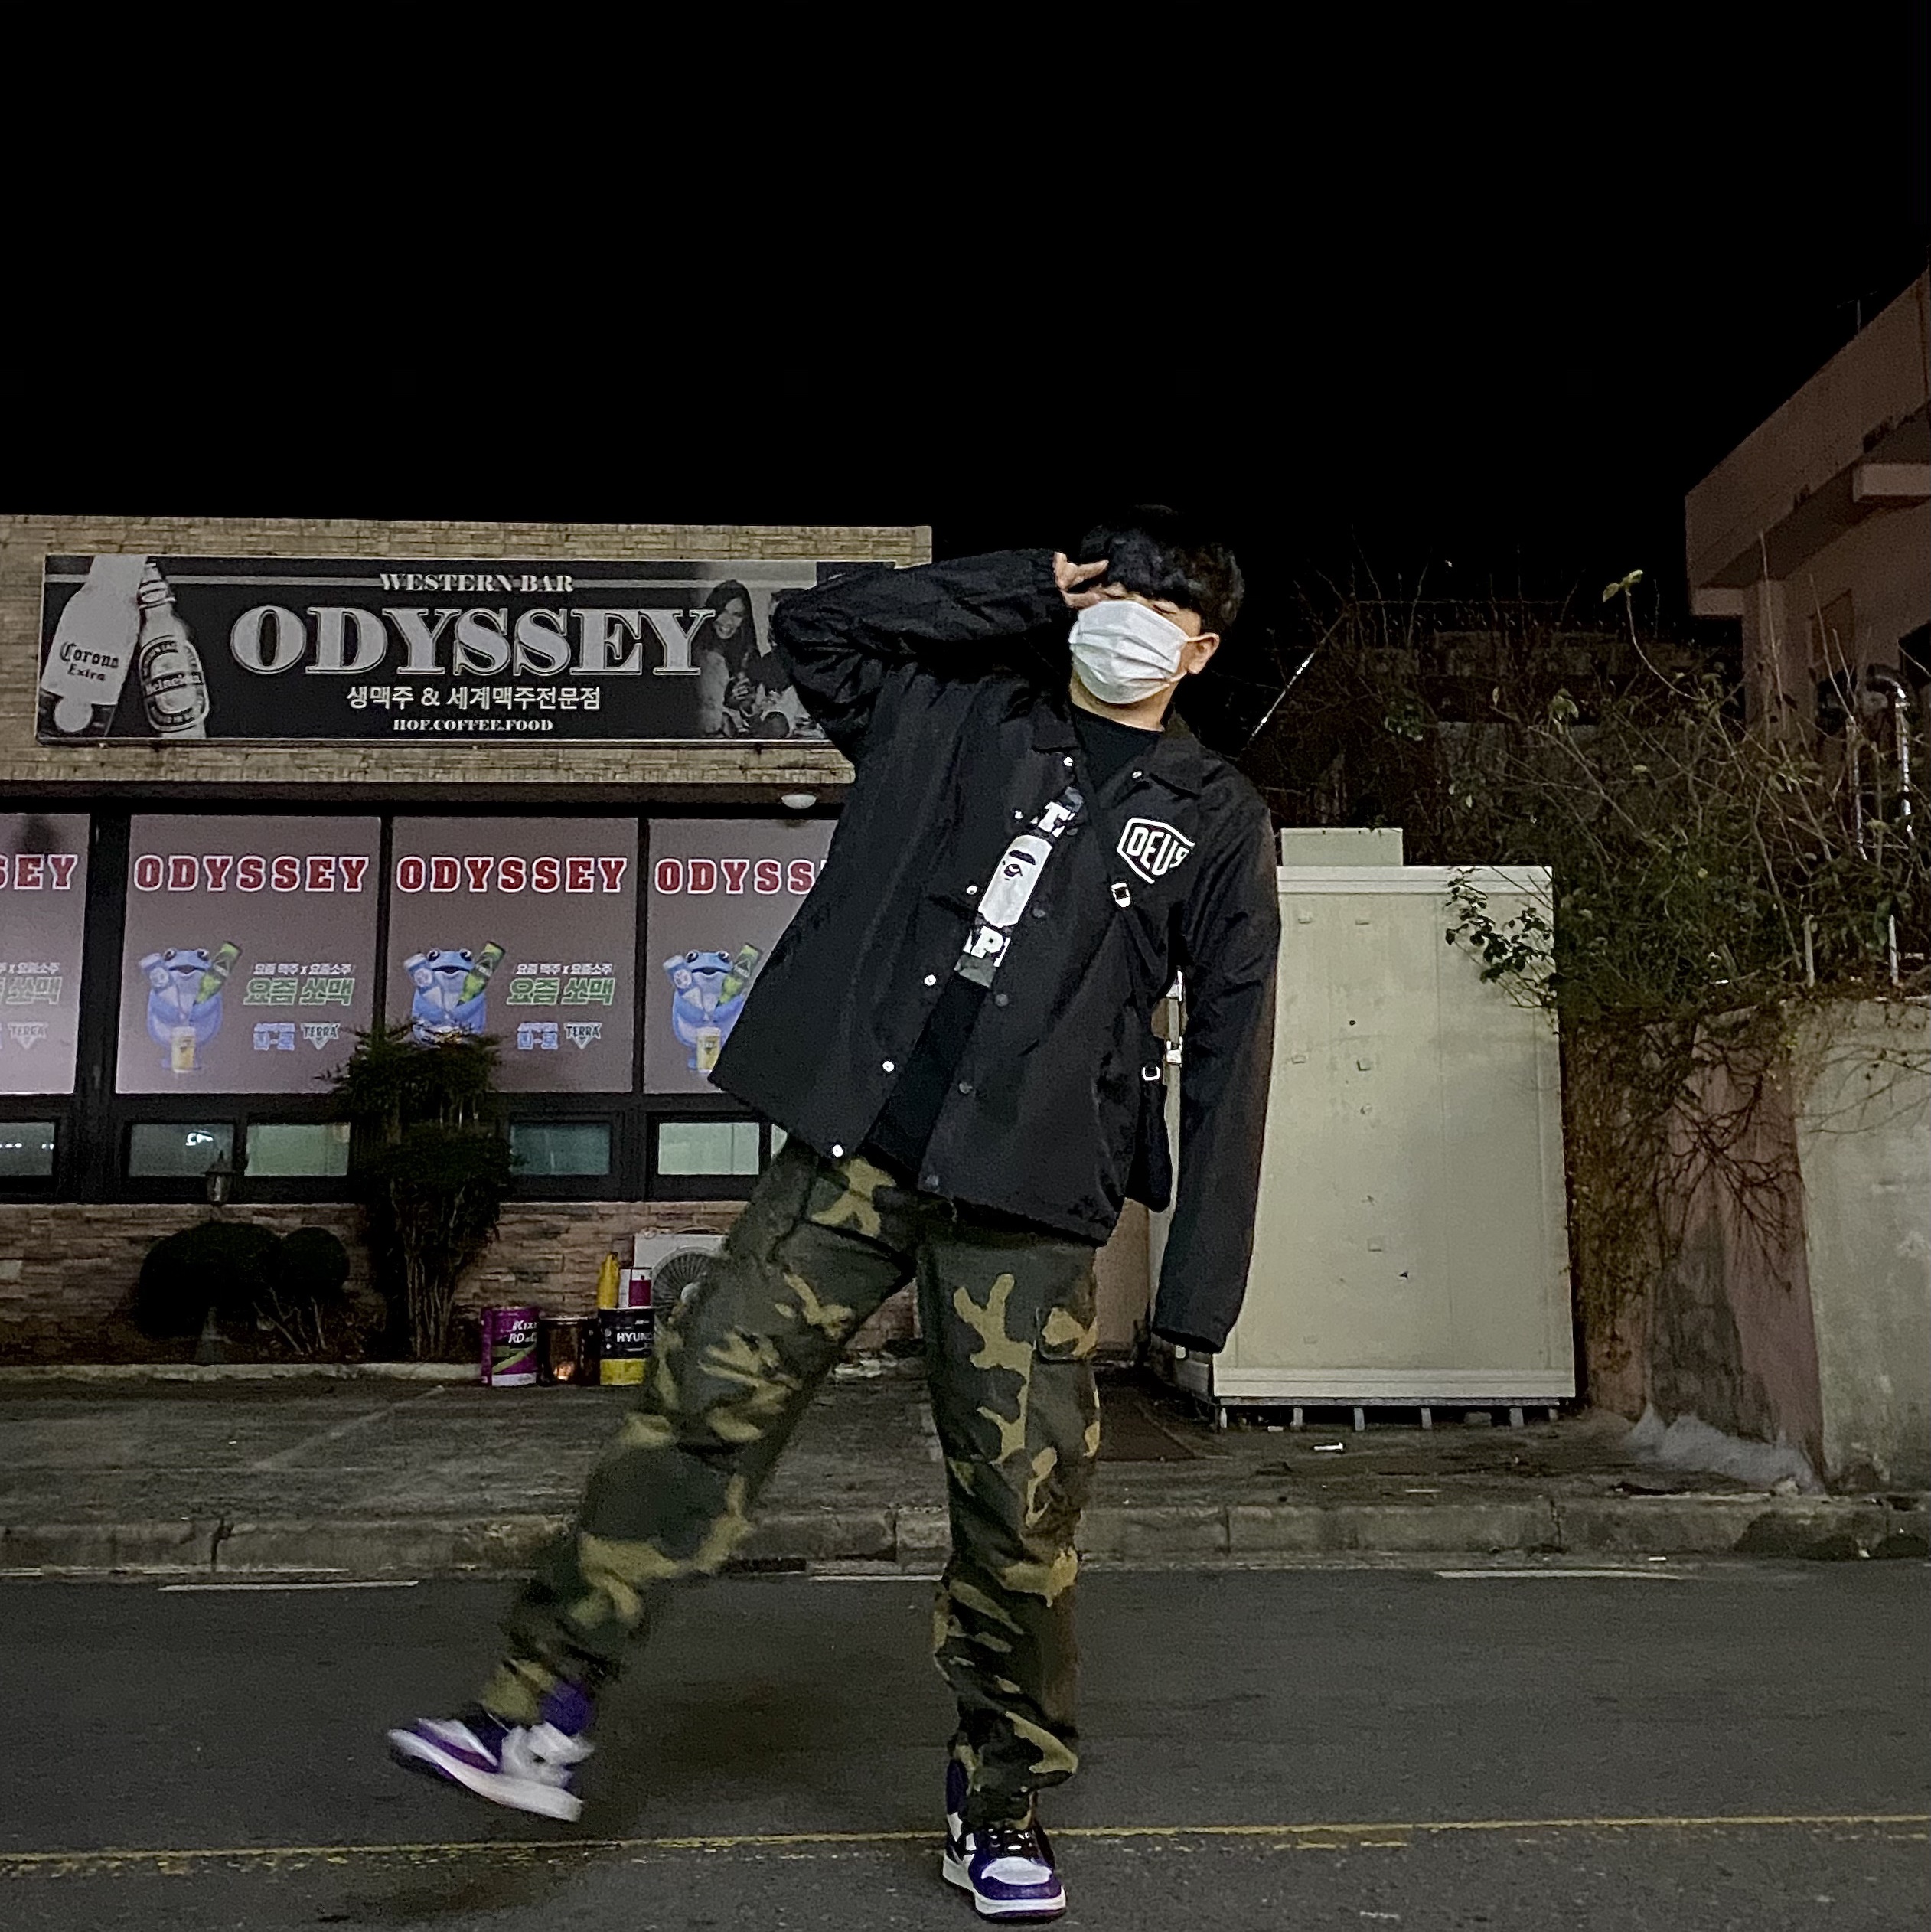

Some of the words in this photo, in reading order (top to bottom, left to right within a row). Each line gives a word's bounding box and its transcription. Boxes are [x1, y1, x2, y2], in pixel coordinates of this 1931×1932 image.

[380, 573, 513, 592] WESTERN
[520, 574, 574, 592] BAR
[60, 641, 119, 668] Corona
[230, 605, 716, 676] ODYSSEY
[347, 686, 414, 710] 생맥주
[421, 687, 441, 707] &
[446, 686, 601, 710] 세계맥주전문점
[1126, 827, 1190, 876] DEUS
[134, 854, 369, 892] ODYSSEY
[396, 856, 627, 893] ODYSSEY
[654, 858, 827, 894] ODYSS
[243, 977, 298, 1006] 요즘
[298, 977, 356, 1006] 쏘맥
[506, 977, 560, 1006] 요즘
[560, 977, 616, 1006] 쏘맥
[304, 1026, 338, 1038] TERRA
[566, 1026, 601, 1038] TERRA
